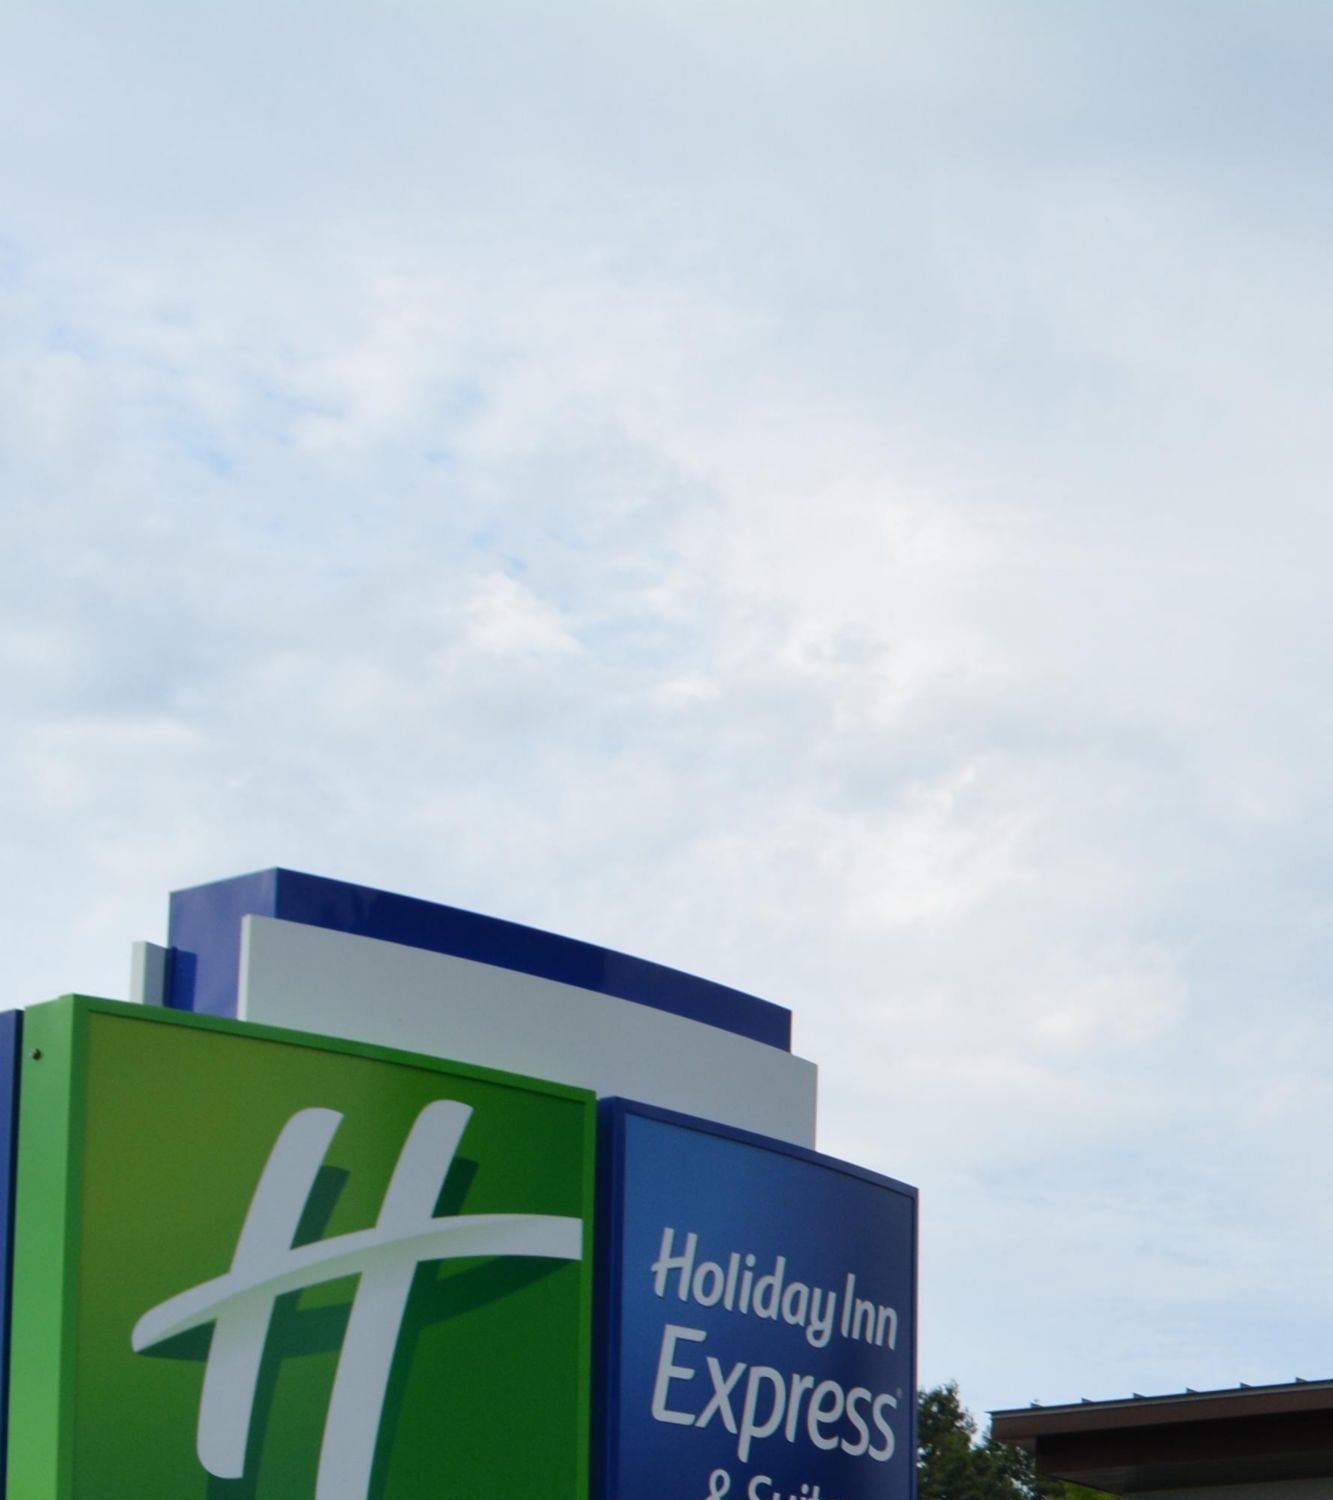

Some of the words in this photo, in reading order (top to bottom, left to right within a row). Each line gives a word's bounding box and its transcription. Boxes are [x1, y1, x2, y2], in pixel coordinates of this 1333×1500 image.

[651, 1227, 836, 1348] Holiday
[841, 1272, 897, 1350] Inn
[651, 1323, 897, 1463] Express
